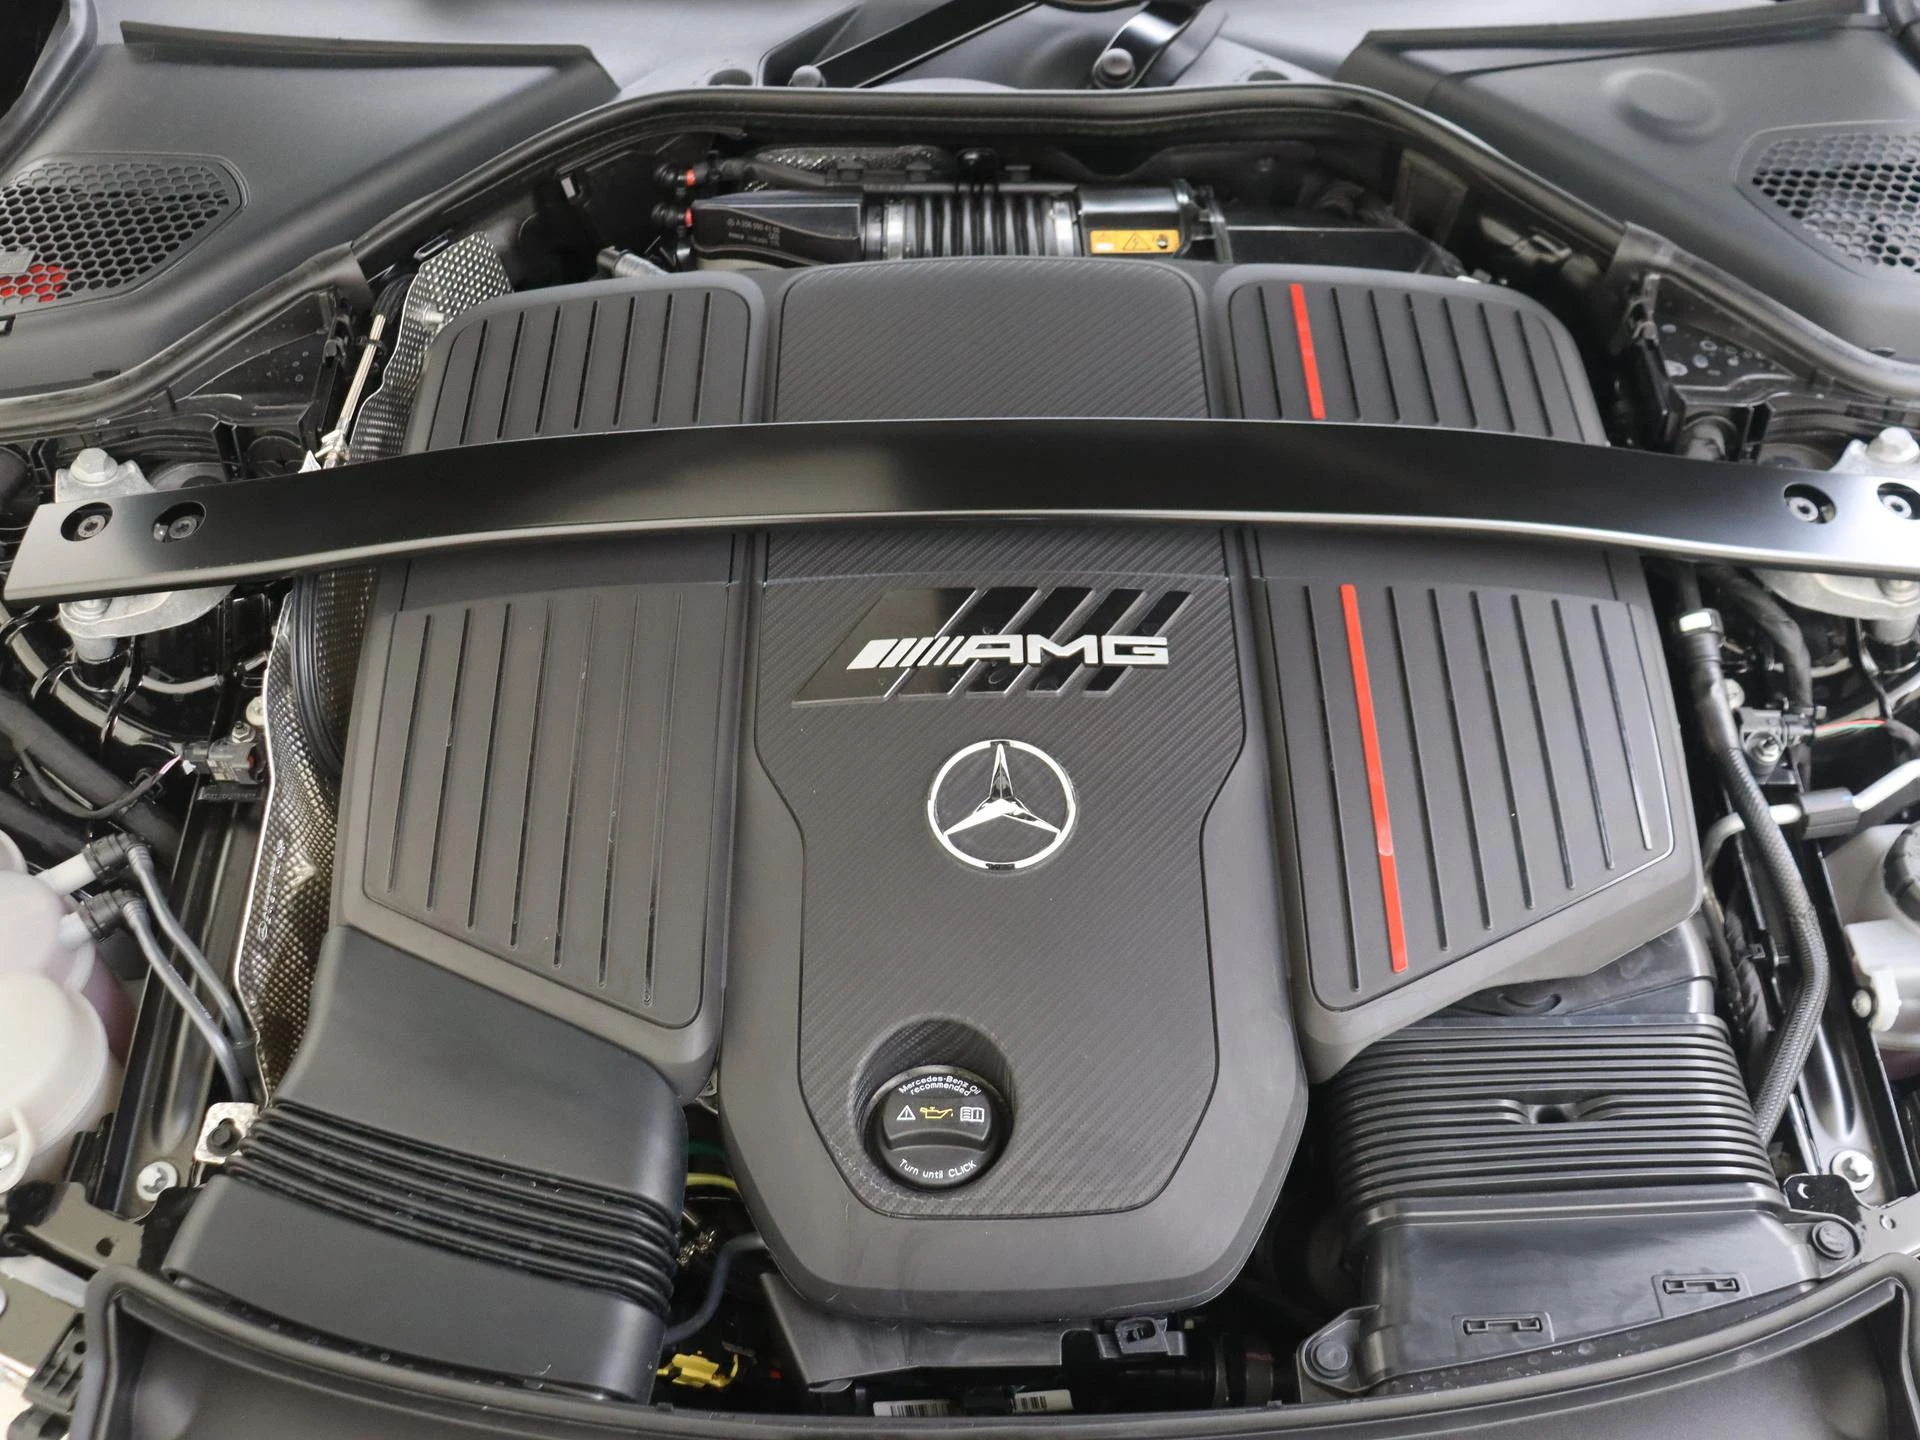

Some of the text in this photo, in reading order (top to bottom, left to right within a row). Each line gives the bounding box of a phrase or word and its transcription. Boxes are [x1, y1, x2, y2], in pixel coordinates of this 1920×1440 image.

[949, 634, 1169, 665] AMG
[898, 1075, 982, 1096] Mercedes-Benz Oil
[910, 1082, 972, 1096] recommended
[899, 1158, 977, 1179] Turn until CLICK
